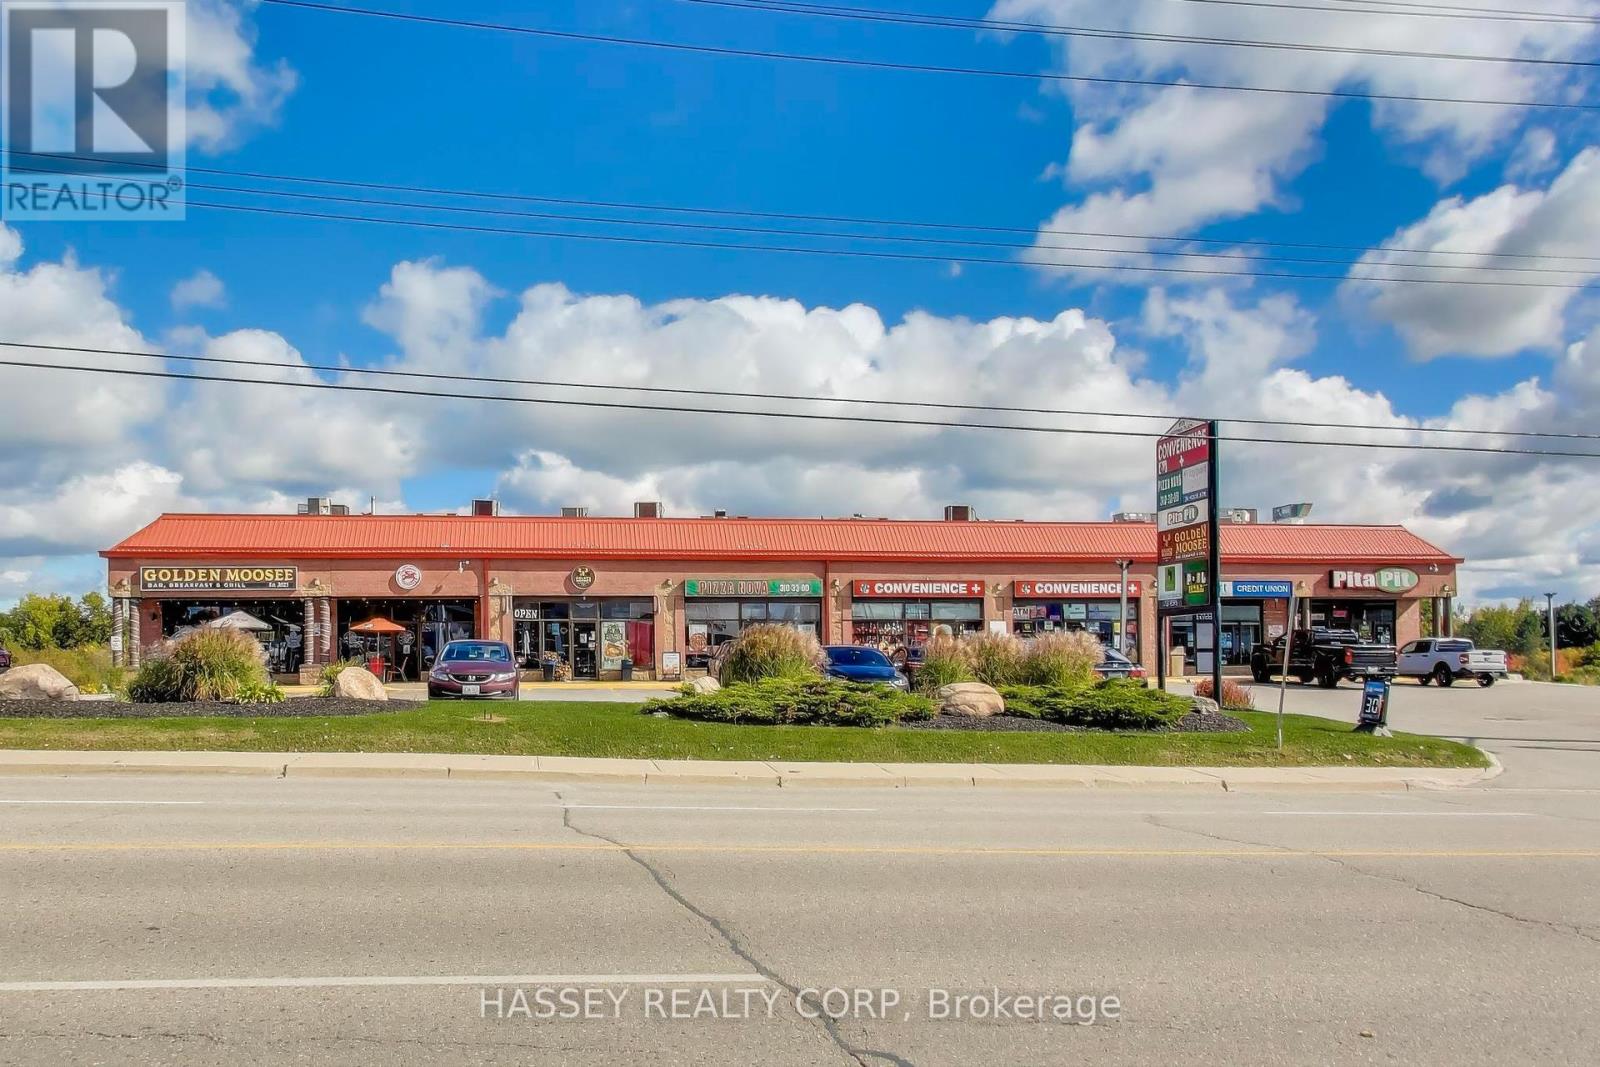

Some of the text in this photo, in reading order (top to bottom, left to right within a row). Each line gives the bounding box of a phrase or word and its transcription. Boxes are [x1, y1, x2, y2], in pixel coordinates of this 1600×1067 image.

[1174, 523, 1207, 543] GOLDEN
[1175, 538, 1207, 554] MOOSEE
[144, 568, 294, 582] GOLDEN MOOSEE
[1333, 570, 1411, 588] Pita Pit
[699, 580, 735, 595] PIZZA
[738, 580, 768, 595] NOVA
[874, 582, 968, 594] CONVENIENCE
[1034, 582, 1122, 594] CONVENIENCE
[1236, 585, 1289, 593] CREDIT UNION
[514, 609, 538, 619] OPEN
[1013, 607, 1029, 615] ATM
